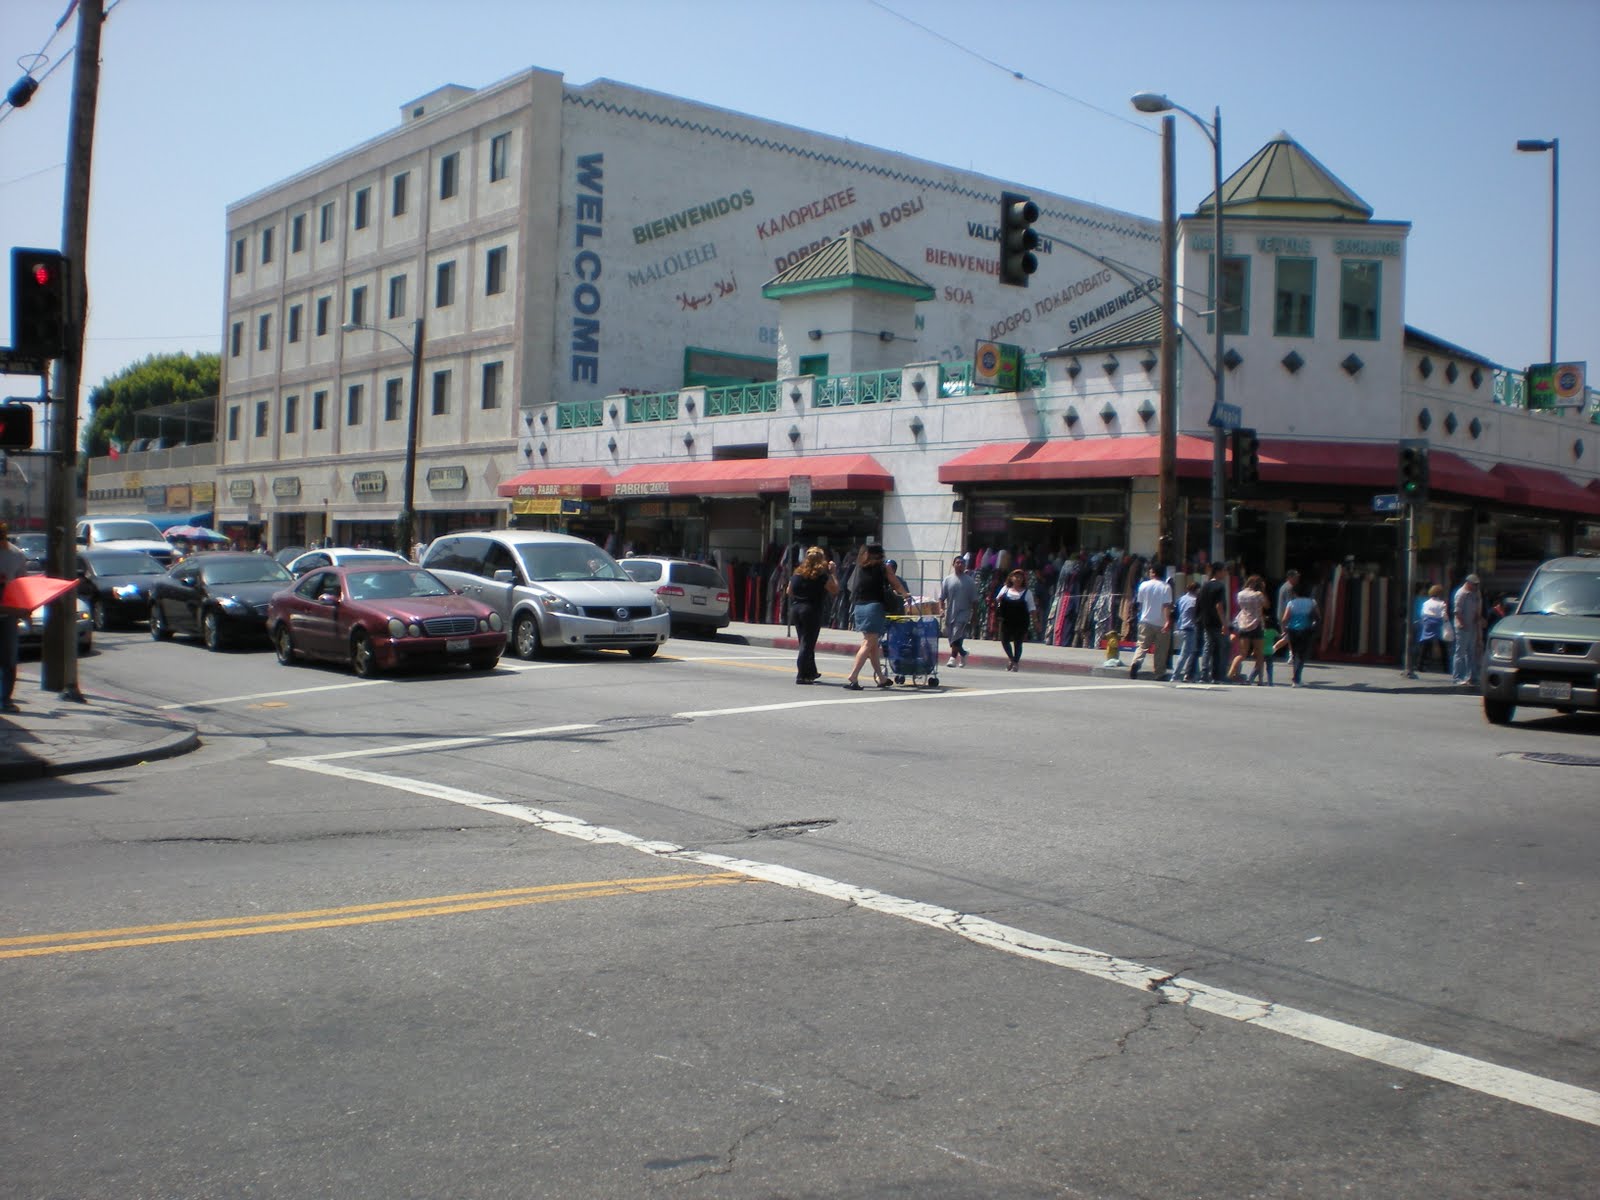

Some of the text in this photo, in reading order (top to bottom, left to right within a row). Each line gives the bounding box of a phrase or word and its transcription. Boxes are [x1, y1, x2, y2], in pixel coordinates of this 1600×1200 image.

[632, 189, 755, 245] BIENVENIDOS
[879, 195, 925, 228] DOSLI
[572, 153, 604, 384] WELCOME
[627, 242, 718, 289] MALOLELEI
[944, 285, 975, 304] SOA
[615, 483, 650, 495] FABRIC
